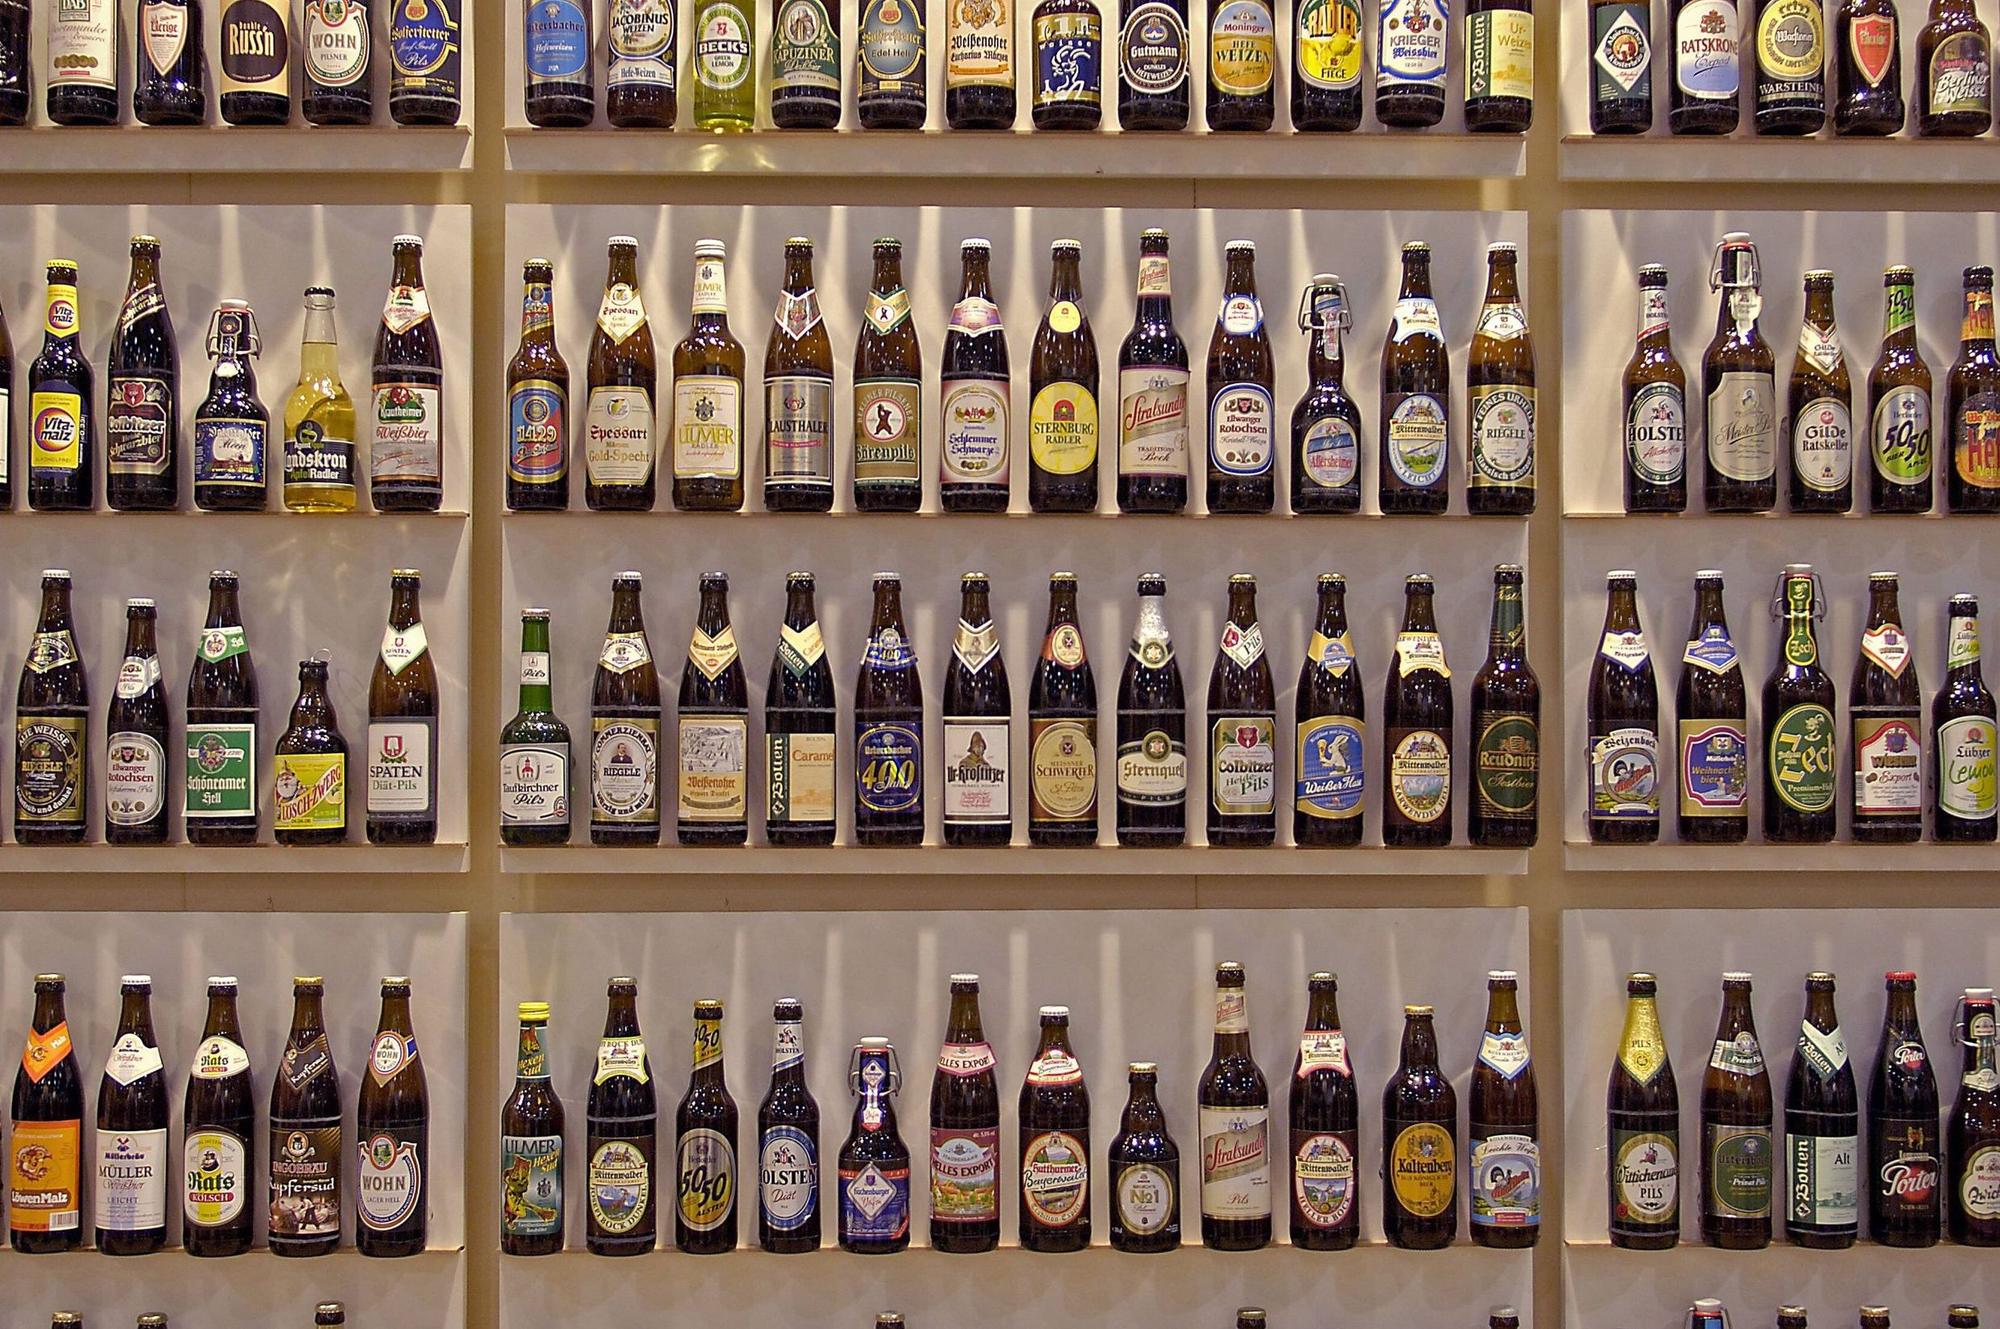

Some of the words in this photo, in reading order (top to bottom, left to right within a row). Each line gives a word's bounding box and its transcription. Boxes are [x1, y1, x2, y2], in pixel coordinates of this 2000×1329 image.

[611, 13, 668, 29] JACOBINUS
[1310, 2, 1358, 38] RADLER
[622, 23, 655, 34] WEIZEN
[1223, 23, 1264, 34] Moninger
[1509, 22, 1527, 35] Ur-
[313, 33, 357, 50] WOHN
[699, 42, 748, 55] BECK'S
[1231, 40, 1255, 50] HEFE
[1390, 37, 1441, 50] KRIEGER
[1681, 38, 1739, 56] RATSKRONE
[320, 54, 348, 63] PILSNER
[772, 49, 834, 64] KAPUZINER
[871, 48, 890, 58] Edel
[1130, 45, 1178, 58] Gutmann
[1216, 50, 1269, 64] WEIZEN
[1392, 48, 1438, 61] Weissbier
[402, 56, 428, 67] Pils
[711, 60, 734, 69] LEMON
[621, 66, 656, 79] Hefe-Weizen
[1321, 68, 1347, 80] FIEGE
[1937, 70, 1990, 93] Berliner
[1945, 84, 1987, 105] Weisse
[1887, 289, 1905, 313] 50
[1475, 393, 1508, 423] FEINES
[43, 416, 74, 432] Vita-
[1033, 421, 1094, 437] STERNBURG
[1219, 423, 1268, 436] Rotochsen
[40, 430, 71, 443] malz
[376, 425, 429, 442] Weißbier
[516, 424, 558, 444] 1429
[590, 425, 648, 441] Spessart
[678, 427, 735, 447] ULMER
[948, 432, 998, 447] Schlemmer
[1045, 435, 1081, 446] RADLER
[1485, 427, 1527, 441] RIEGELE
[1804, 425, 1847, 441] Gilde
[1802, 438, 1849, 453] Ratskeller
[1882, 420, 1915, 456] 50
[1903, 429, 1931, 462] 50
[588, 451, 649, 465] Gold-Specht
[951, 444, 995, 458] Schwarze
[1141, 451, 1169, 464] Bock
[1401, 467, 1438, 484] LEICHT
[1242, 633, 1264, 658] Pils
[880, 647, 903, 661] 400
[521, 668, 548, 681] Pils
[33, 724, 71, 749] WEISSE
[1602, 735, 1656, 751] Weizenbock
[1955, 745, 1991, 758] Lübzer
[22, 759, 65, 773] RIEGELE
[369, 765, 423, 779] SPATEN
[603, 767, 641, 780] RIEGELE
[772, 737, 785, 799] Bolten
[1035, 763, 1095, 780] SCHWERTER
[1122, 761, 1185, 781] Sternquell
[1949, 759, 1995, 785] Lemon
[108, 771, 154, 784] Rotochsen
[862, 759, 917, 791] 400
[1878, 769, 1913, 786] Export
[372, 779, 417, 791] Diät-Pils
[502, 782, 559, 796] Taufkirchner
[1240, 776, 1272, 797] Pils
[281, 765, 342, 822] LÖSCH-ZWERG
[513, 792, 545, 807] Pils
[36, 801, 54, 814] und
[1395, 784, 1440, 820] KARWENDEL
[616, 804, 635, 816] und
[1631, 1040, 1653, 1049] PILS
[201, 1054, 229, 1067] Rats
[962, 1055, 991, 1070] EXPORT
[504, 1138, 556, 1158] ULMER
[104, 1151, 144, 1161] Müllerbräu
[1833, 1152, 1851, 1166] Alt
[98, 1163, 153, 1180] MÜLLER
[960, 1158, 994, 1177] EXPORT
[1395, 1159, 1452, 1176] Kaltenberg
[1795, 1139, 1810, 1202] Bolten
[188, 1171, 236, 1192] Rats
[362, 1173, 406, 1191] WOHN
[679, 1166, 706, 1199] 50
[699, 1172, 727, 1208] 50
[1881, 1164, 1939, 1197] Porter
[11, 1190, 69, 1206] LöwenMalz
[107, 1196, 138, 1206] LEICHT
[191, 1193, 231, 1204] KÖLSCH
[366, 1196, 385, 1205] LAGER
[770, 1187, 798, 1204] Diät
[1226, 1194, 1250, 1206] Pils
[1639, 1186, 1663, 1201] PILS
[694, 1203, 725, 1218] ALSTER
[1297, 1196, 1329, 1225] HELLER
[1331, 1196, 1350, 1221] BOCK
[601, 1211, 628, 1231] BOCK
